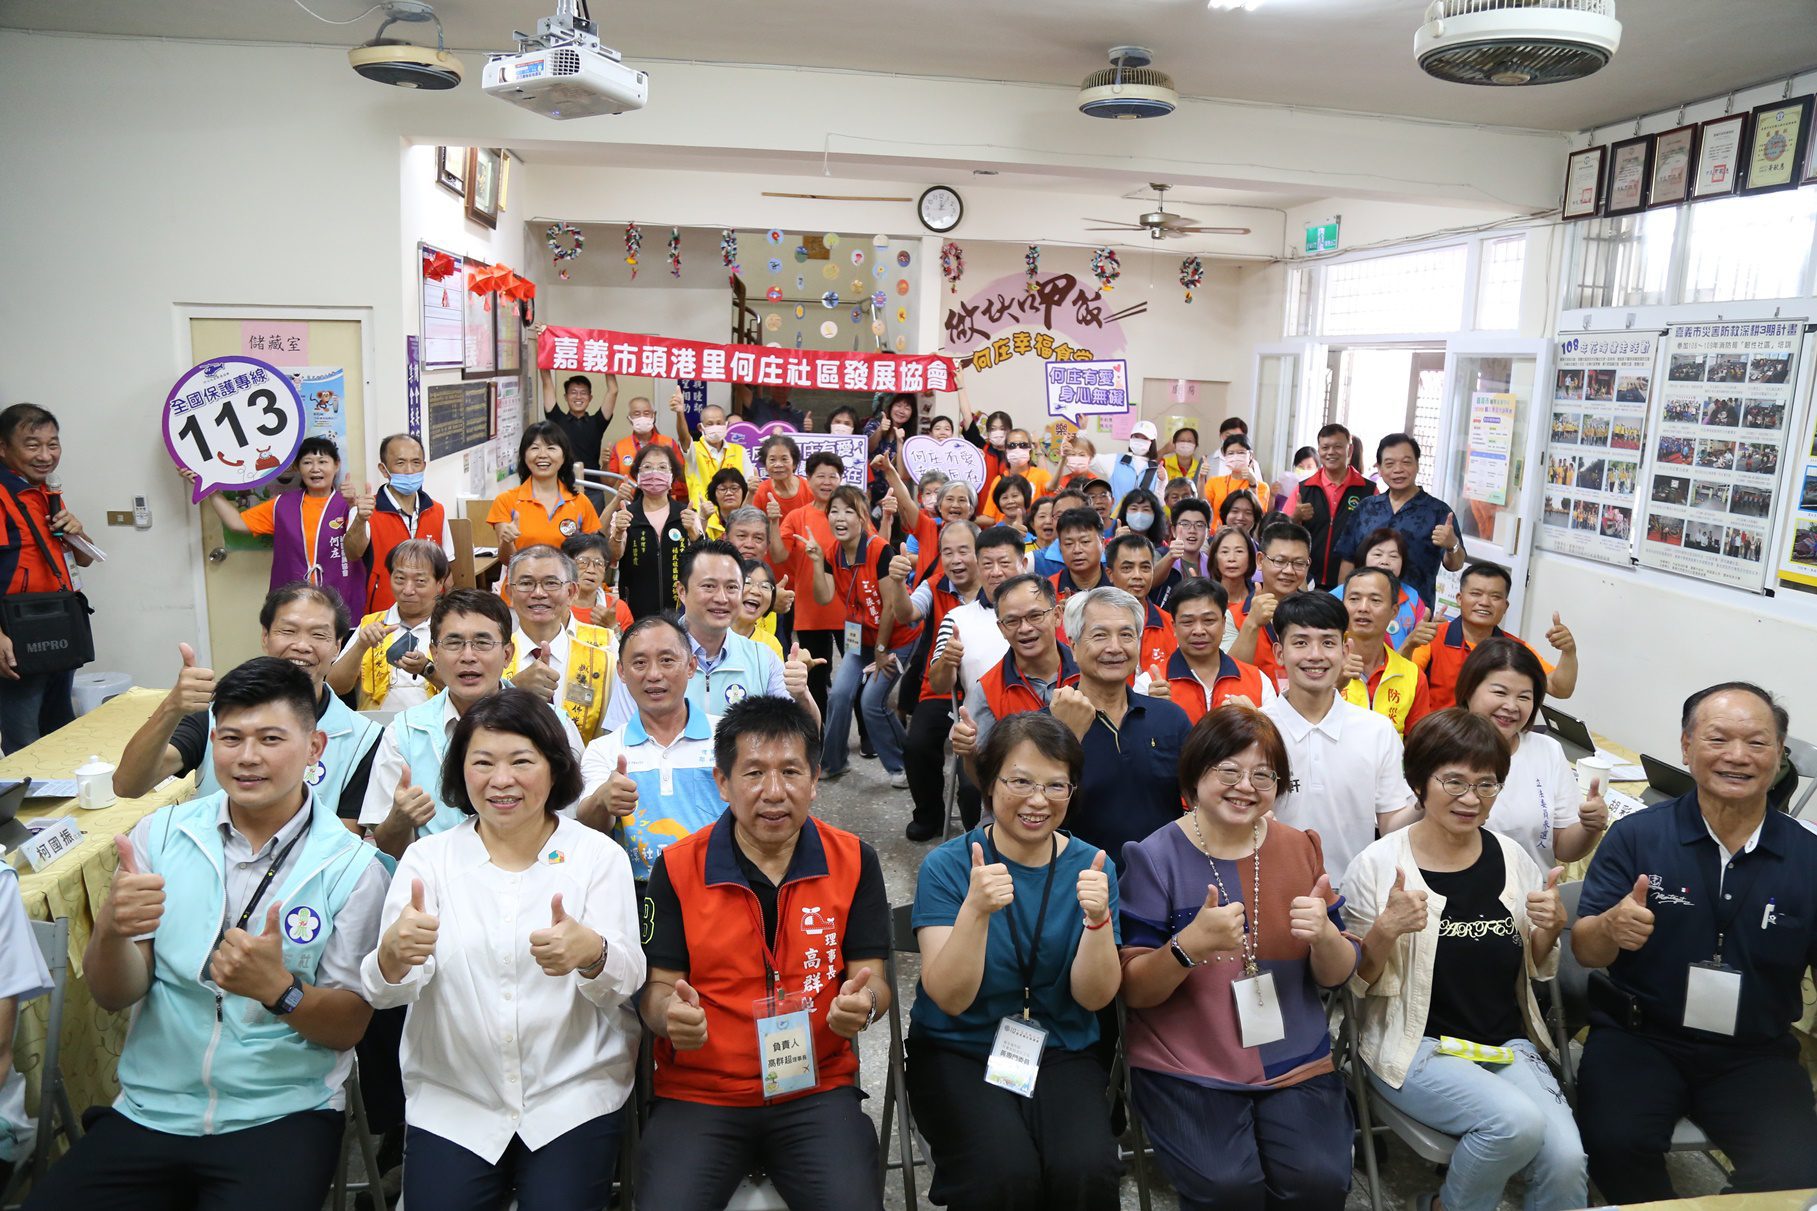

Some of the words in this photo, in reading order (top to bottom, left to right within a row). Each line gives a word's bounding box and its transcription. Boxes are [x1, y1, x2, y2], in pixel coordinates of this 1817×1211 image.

[250, 335, 301, 352] 儲藏室
[552, 336, 949, 392] 嘉義市頭港里何庄社區發展協會
[1050, 366, 1115, 387] 何庄有愛
[171, 368, 270, 416] 全國保護專線
[178, 388, 288, 462] 113
[329, 536, 342, 559] 何庄
[27, 639, 69, 653] MIPRO
[36, 828, 75, 862] 柯國振
[825, 932, 837, 980] 理事長
[773, 1038, 799, 1052] 負責人
